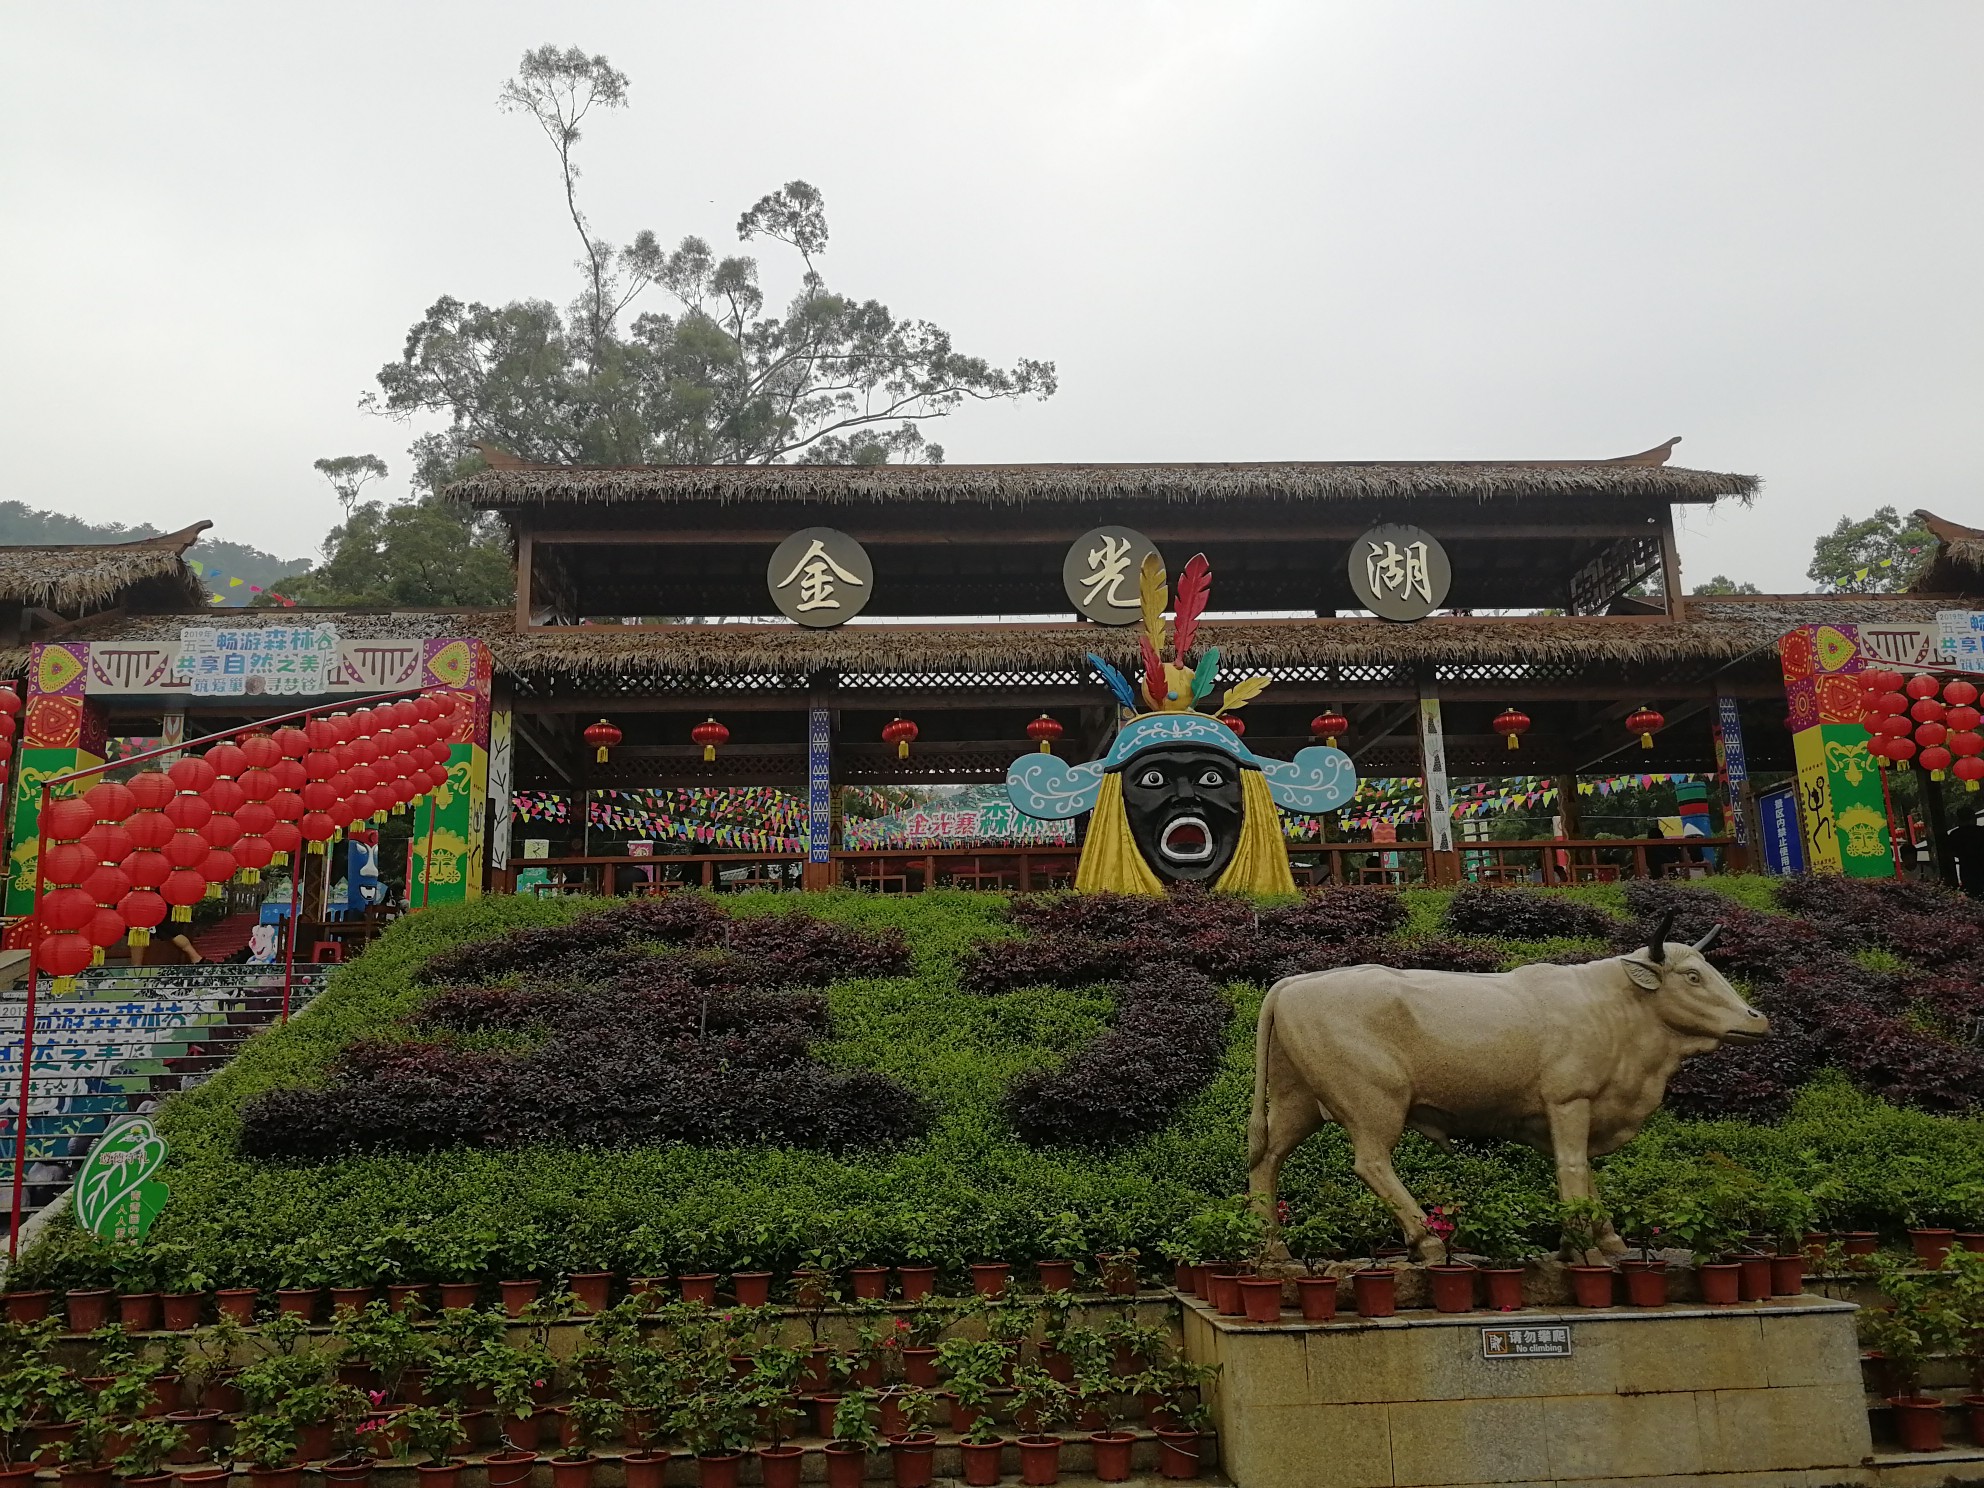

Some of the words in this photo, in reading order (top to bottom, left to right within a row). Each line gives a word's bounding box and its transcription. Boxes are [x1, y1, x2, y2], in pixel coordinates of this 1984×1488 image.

[184, 630, 213, 638] 2019年
[1940, 636, 1984, 655] 共享
[176, 652, 320, 675] 共享自然之美
[194, 677, 243, 693] 筑爱巢
[1509, 1330, 1566, 1343] 请勿攀爬
[1516, 1345, 1528, 1353] No
[1529, 1344, 1562, 1353] climbing
